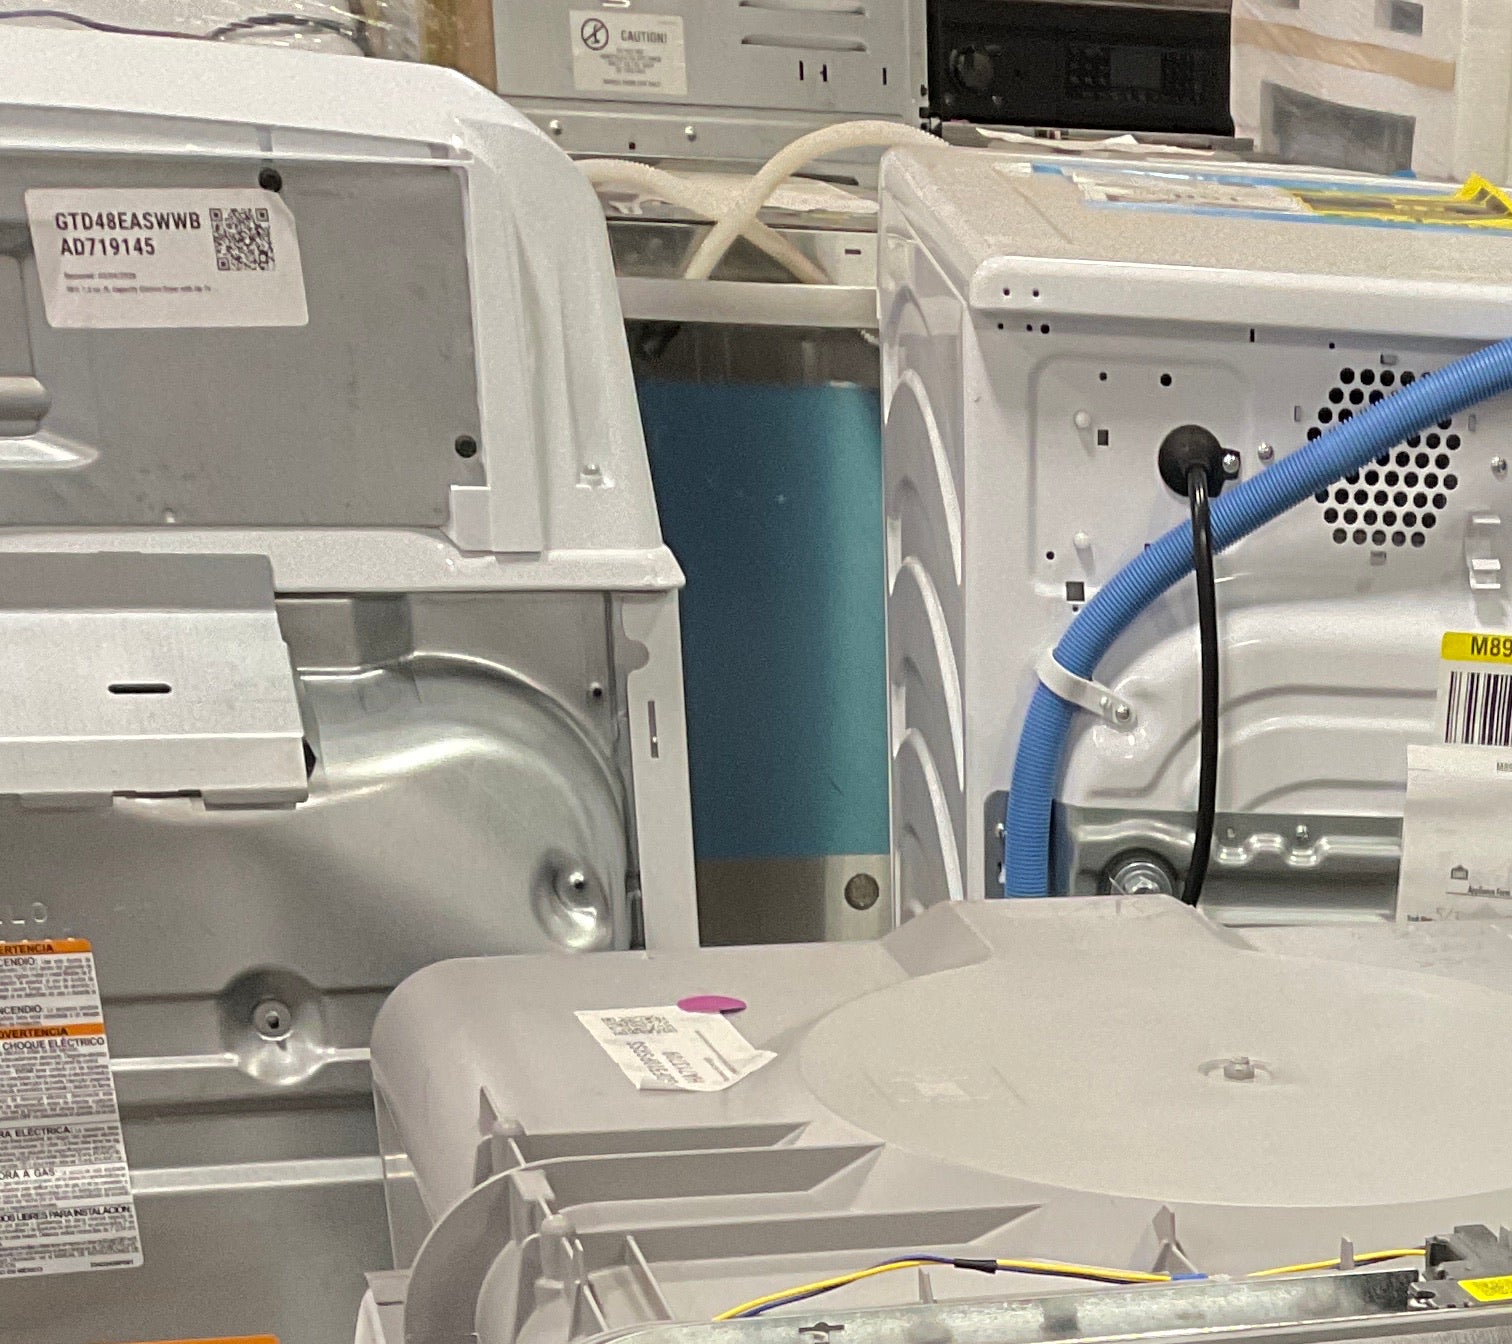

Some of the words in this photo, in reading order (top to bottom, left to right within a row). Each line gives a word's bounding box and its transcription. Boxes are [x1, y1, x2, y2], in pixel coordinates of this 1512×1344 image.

[620, 30, 667, 43] CAUTION!
[55, 212, 201, 230] GTD48EASWWB
[61, 238, 155, 256] AD719145
[3, 1039, 48, 1051] CHOQUE
[23, 1169, 30, 1178] A
